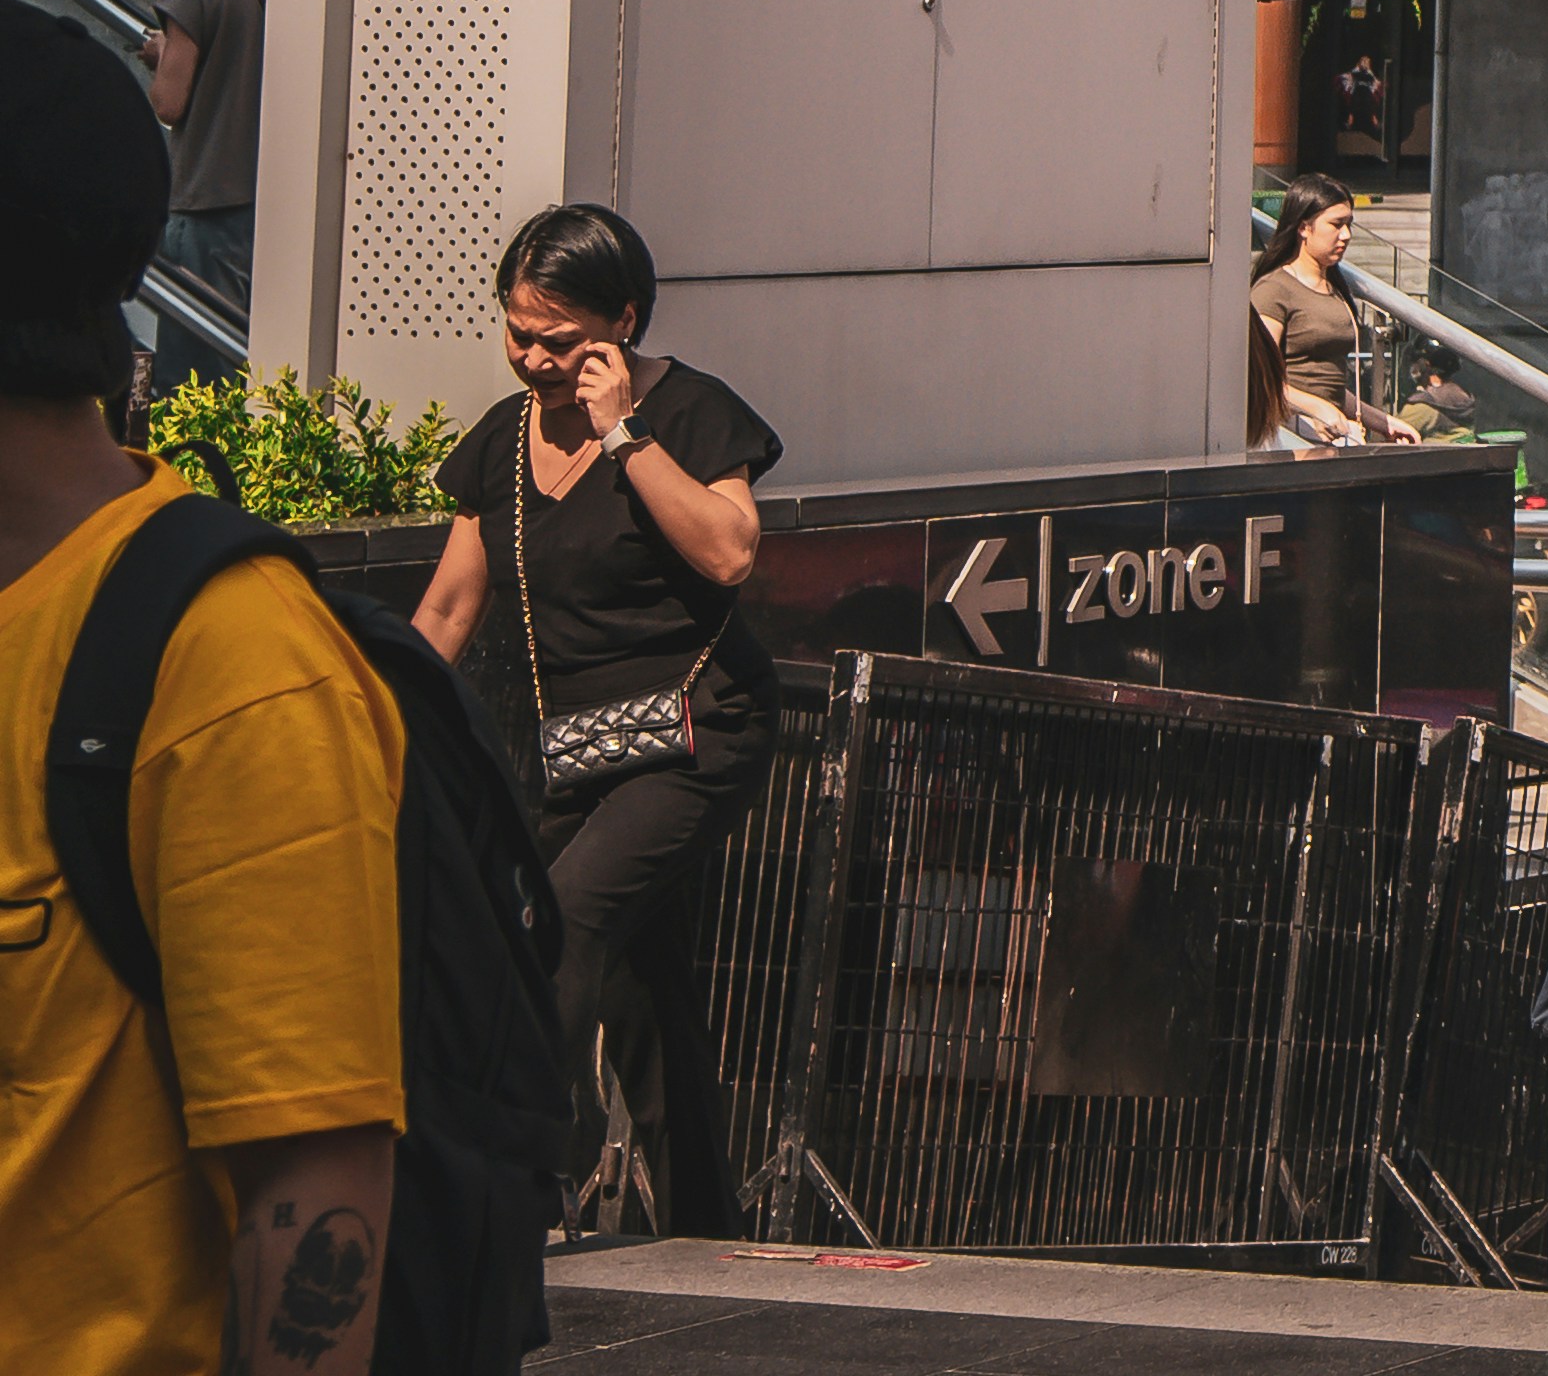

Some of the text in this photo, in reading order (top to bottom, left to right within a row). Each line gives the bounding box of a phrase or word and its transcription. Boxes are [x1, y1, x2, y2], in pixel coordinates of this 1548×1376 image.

[1066, 515, 1284, 624] zone F
[1321, 1245, 1339, 1265] CW
